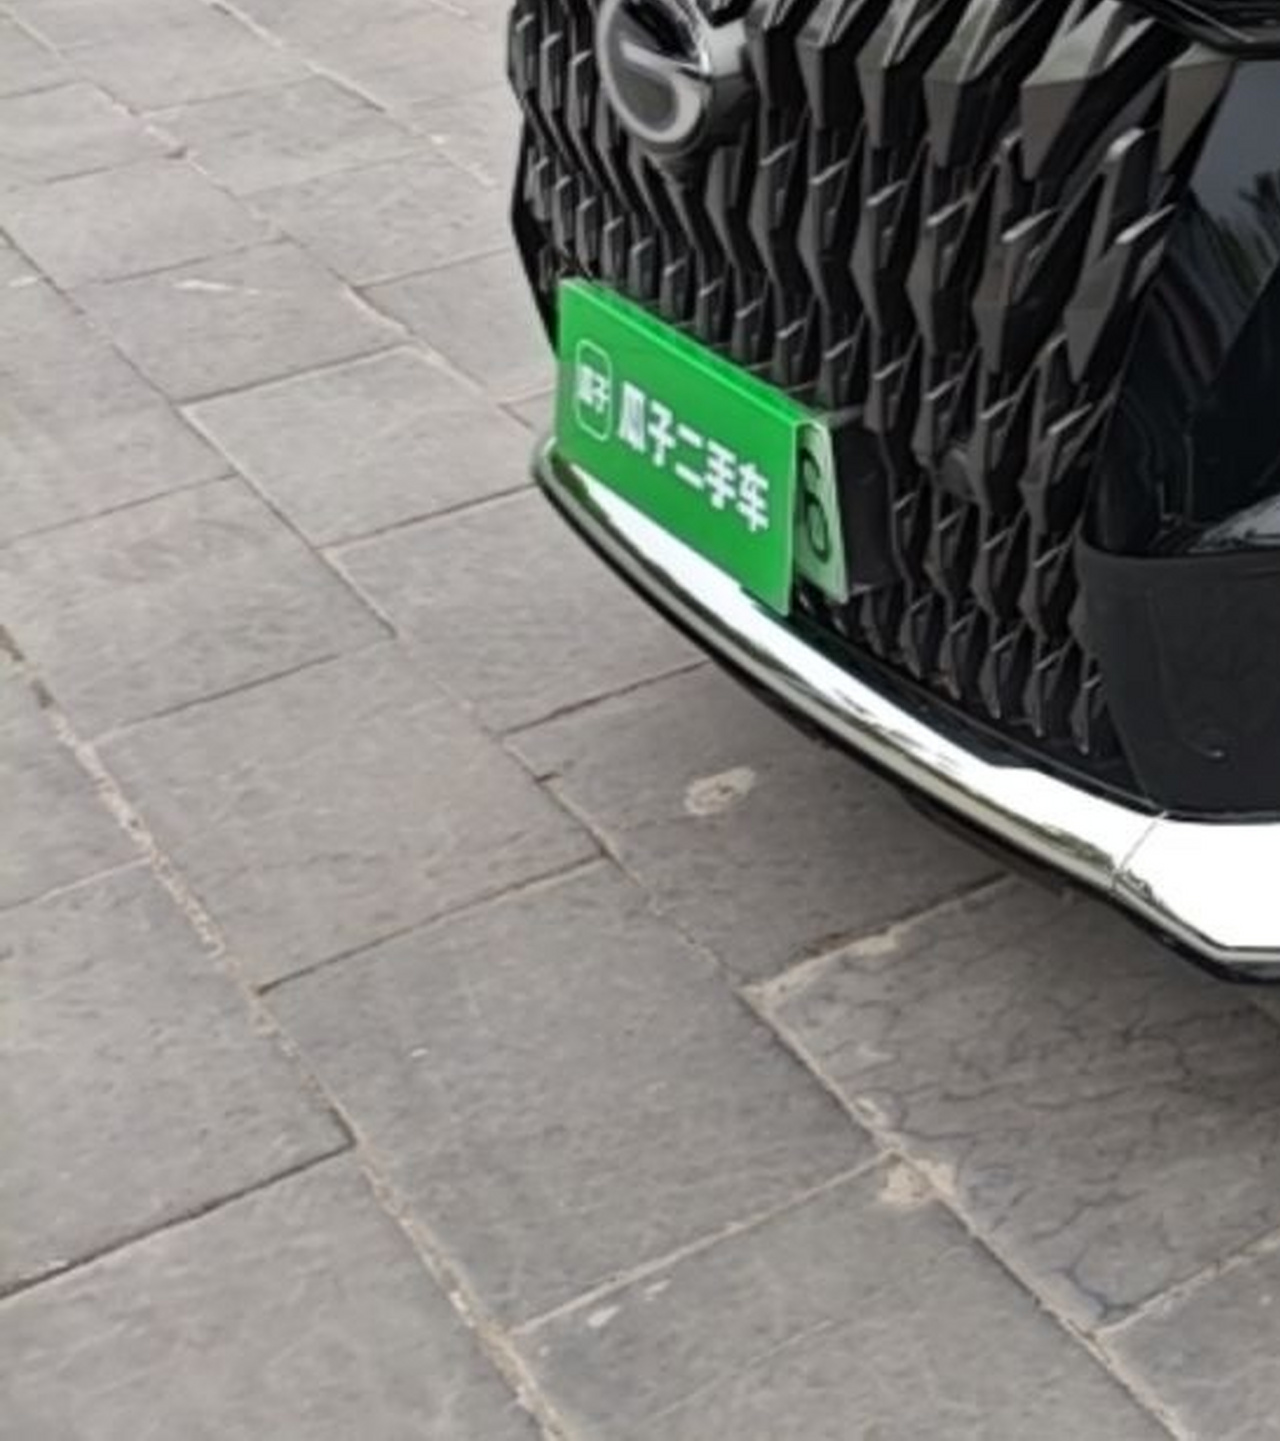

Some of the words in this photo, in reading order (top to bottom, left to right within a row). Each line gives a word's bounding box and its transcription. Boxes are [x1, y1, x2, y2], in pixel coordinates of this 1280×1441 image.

[617, 380, 770, 534] 瓜子二手车
